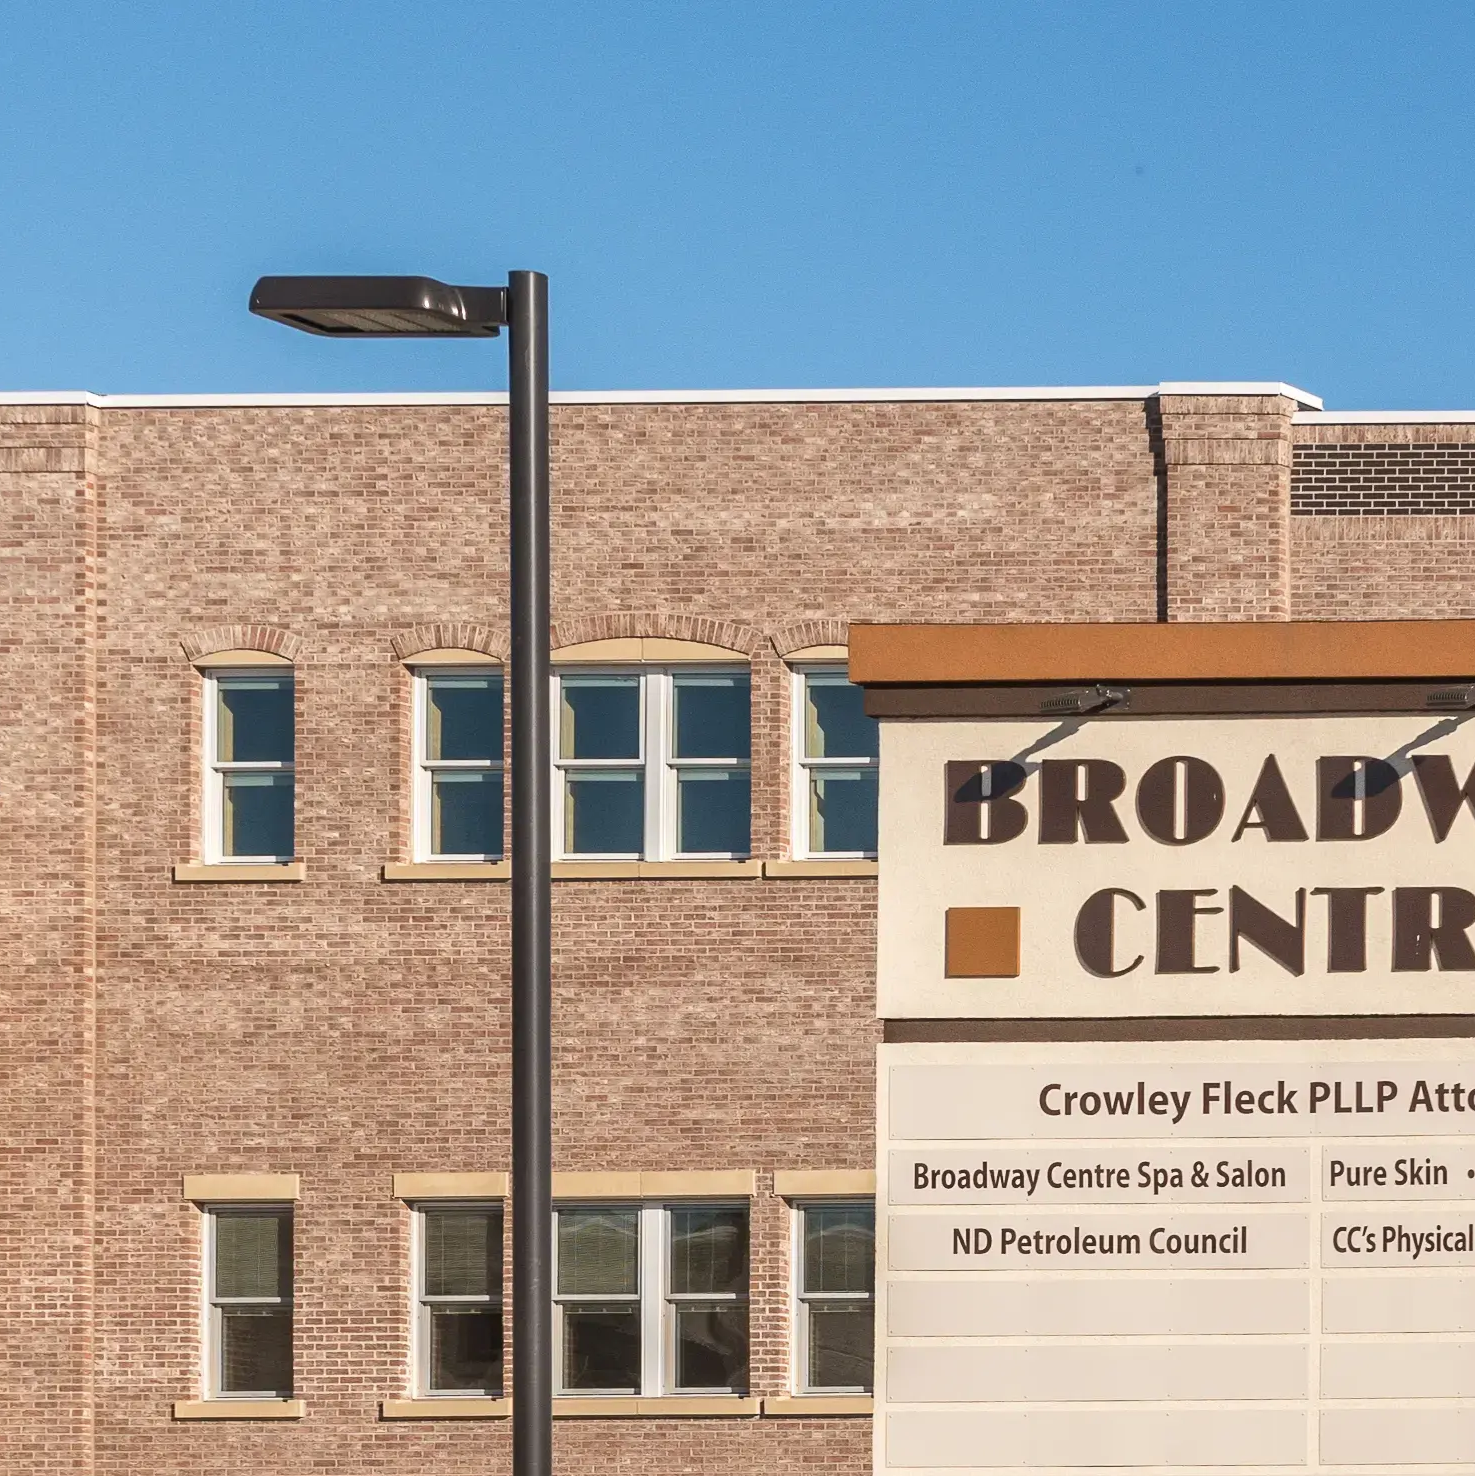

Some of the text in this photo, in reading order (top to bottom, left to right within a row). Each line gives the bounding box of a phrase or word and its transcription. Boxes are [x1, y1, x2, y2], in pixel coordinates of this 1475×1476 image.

[1039, 1081, 1191, 1124] Crowley
[1202, 1080, 1298, 1115] Fleck
[1309, 1080, 1398, 1114] PLLP
[914, 1159, 1286, 1197] Broadway Centre Spa & Salon
[1330, 1157, 1448, 1187] Pure Skin
[953, 1225, 1247, 1255] ND Petroleum Council
[1332, 1225, 1376, 1254] CC's
[1382, 1223, 1474, 1260] Physical
